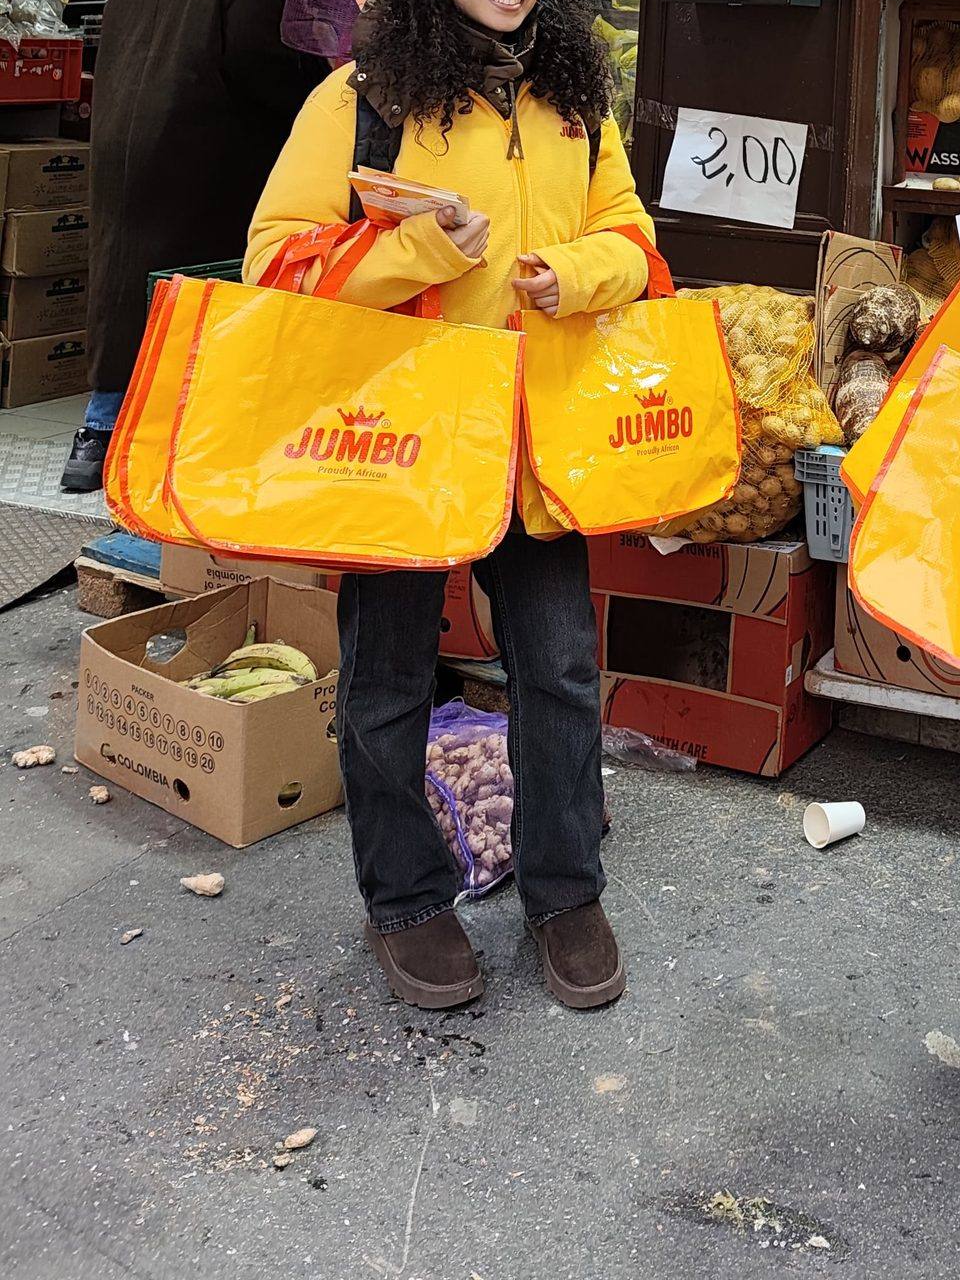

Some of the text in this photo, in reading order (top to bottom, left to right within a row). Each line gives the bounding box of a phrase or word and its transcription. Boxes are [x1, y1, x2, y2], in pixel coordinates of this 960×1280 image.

[560, 126, 587, 140] JUMB
[690, 126, 797, 188] 2,00
[609, 406, 693, 449] JUMBO
[284, 426, 422, 468] JUMBO
[636, 443, 680, 456] Proudly African
[317, 465, 388, 479] Proudly African
[620, 534, 646, 549] CARE
[680, 544, 720, 559] HANDL
[131, 684, 154, 702] PACKER
[103, 687, 108, 696] 2
[113, 694, 119, 703] 3
[126, 700, 133, 709] 4
[140, 706, 145, 715] 5
[152, 712, 158, 721] 6
[165, 719, 172, 728] 7
[180, 725, 186, 735] 8
[195, 731, 202, 741] 9
[210, 736, 222, 748] 10
[96, 705, 104, 717] 12
[105, 713, 114, 725] 13
[117, 719, 127, 731] 14
[130, 726, 141, 738] 15
[144, 733, 155, 744] 16
[157, 739, 168, 750] 17
[171, 745, 182, 757] 18
[185, 751, 197, 764] 19
[202, 757, 214, 769] 20
[681, 741, 708, 760] CARE
[117, 753, 170, 789] COLOMBIA
